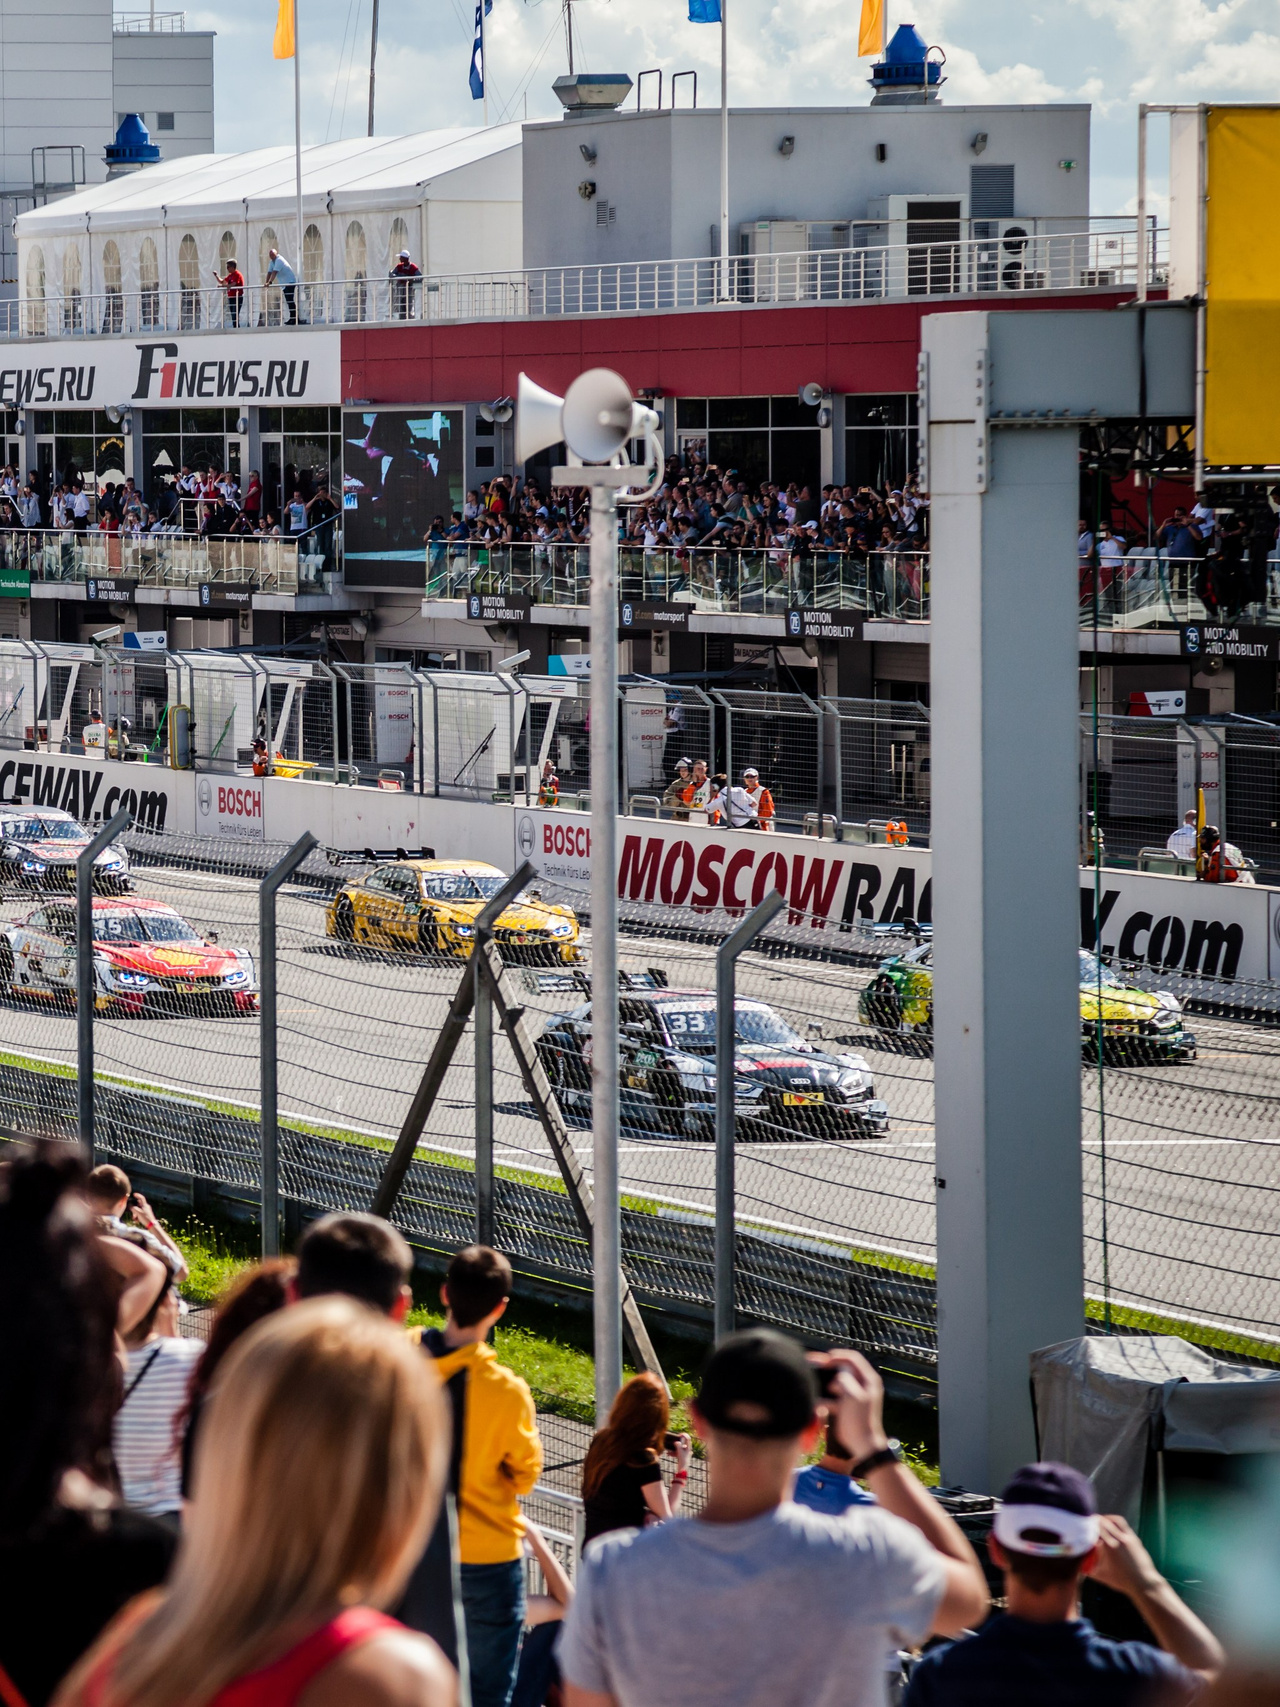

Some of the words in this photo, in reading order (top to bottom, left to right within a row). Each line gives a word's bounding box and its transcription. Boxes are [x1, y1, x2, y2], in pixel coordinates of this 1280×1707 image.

[131, 342, 309, 399] F1NEWS.RU
[97, 581, 115, 590] MOTION
[98, 591, 108, 599] AND
[109, 591, 129, 600] MOBILITY
[482, 596, 505, 607] MOTION
[483, 608, 495, 618] AND
[495, 609, 524, 620] MOBILITY
[804, 612, 831, 624] MOTION
[791, 612, 800, 633] ZF
[805, 624, 820, 636] AND
[821, 625, 854, 638] MOBILITY
[1205, 642, 1223, 655] AND
[1226, 643, 1268, 657] MOBILITY
[218, 787, 262, 817] BOSCH
[218, 822, 237, 835] Technik
[237, 823, 247, 836] fürs
[543, 863, 566, 877] Technik
[567, 865, 578, 878] fürs
[579, 867, 592, 880] Leb
[430, 878, 457, 894] 16
[618, 835, 1244, 984] MOSCOWRAY.com
[670, 1014, 705, 1033] 33
